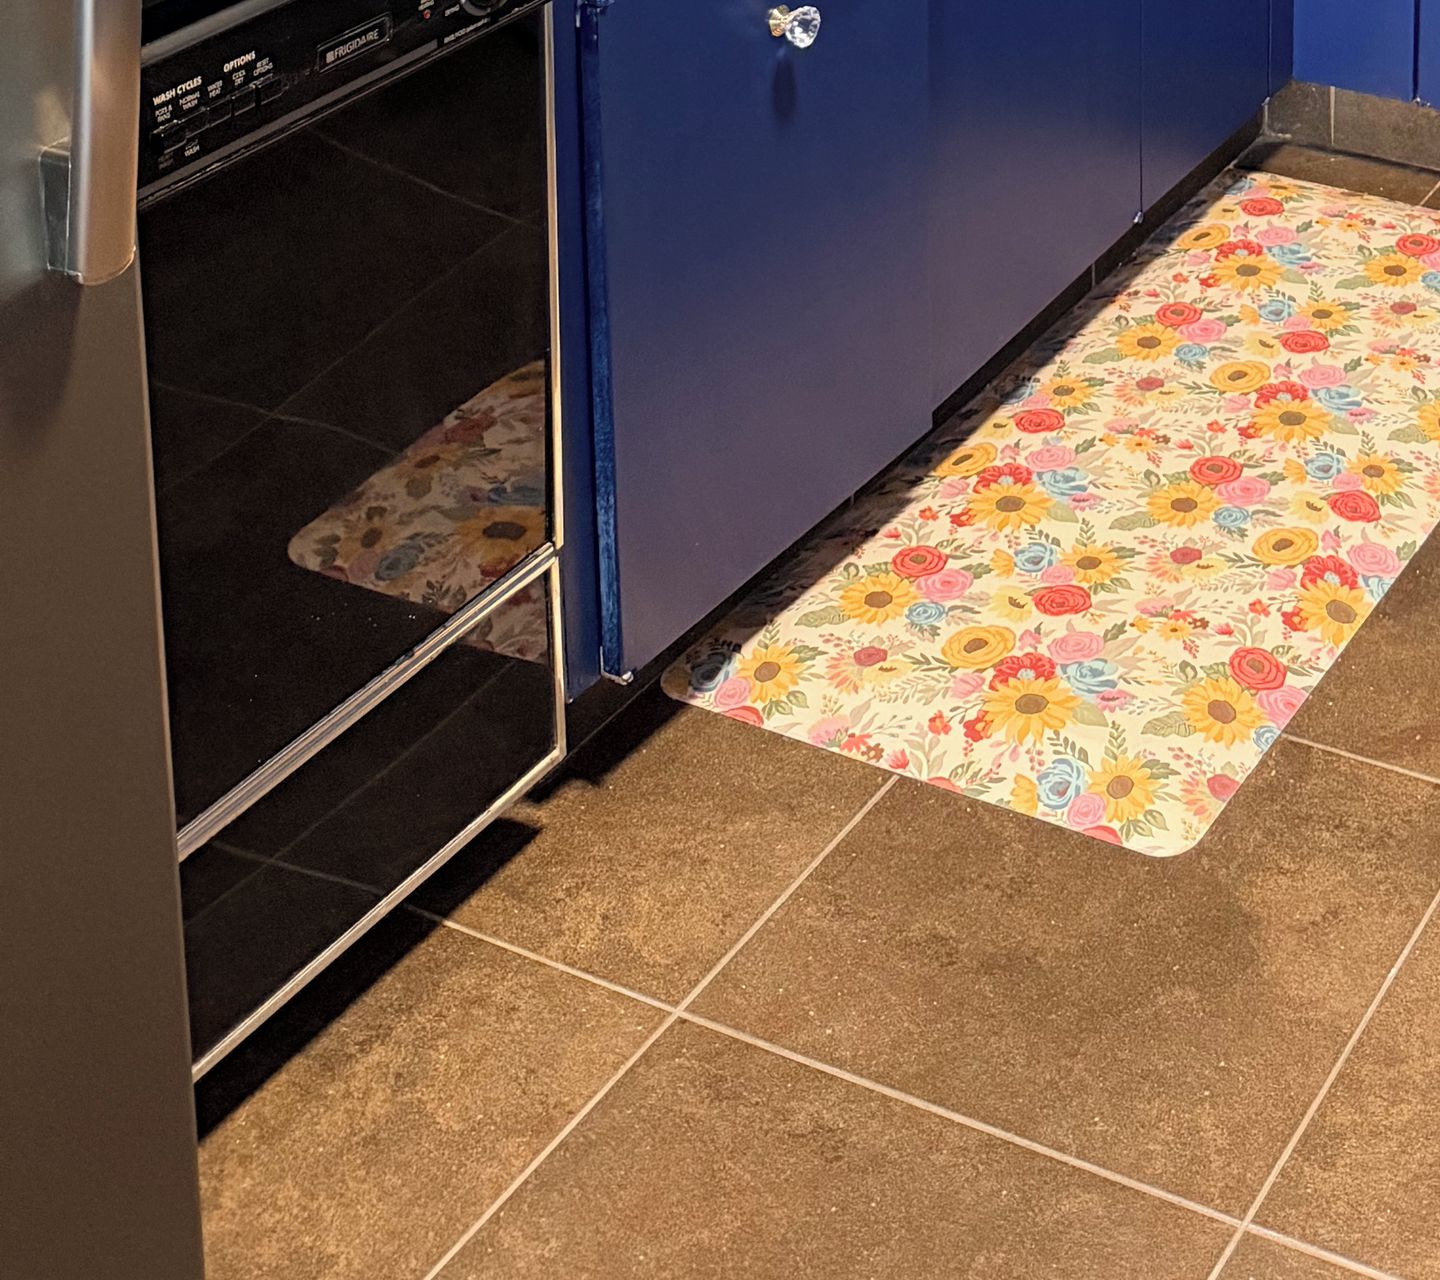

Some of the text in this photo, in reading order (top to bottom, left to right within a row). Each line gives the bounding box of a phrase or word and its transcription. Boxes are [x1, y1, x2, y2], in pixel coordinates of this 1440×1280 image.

[333, 28, 380, 58] FRIGIDAIRE
[223, 50, 256, 73] OPTIONS
[152, 76, 202, 106] WASH CYCLES
